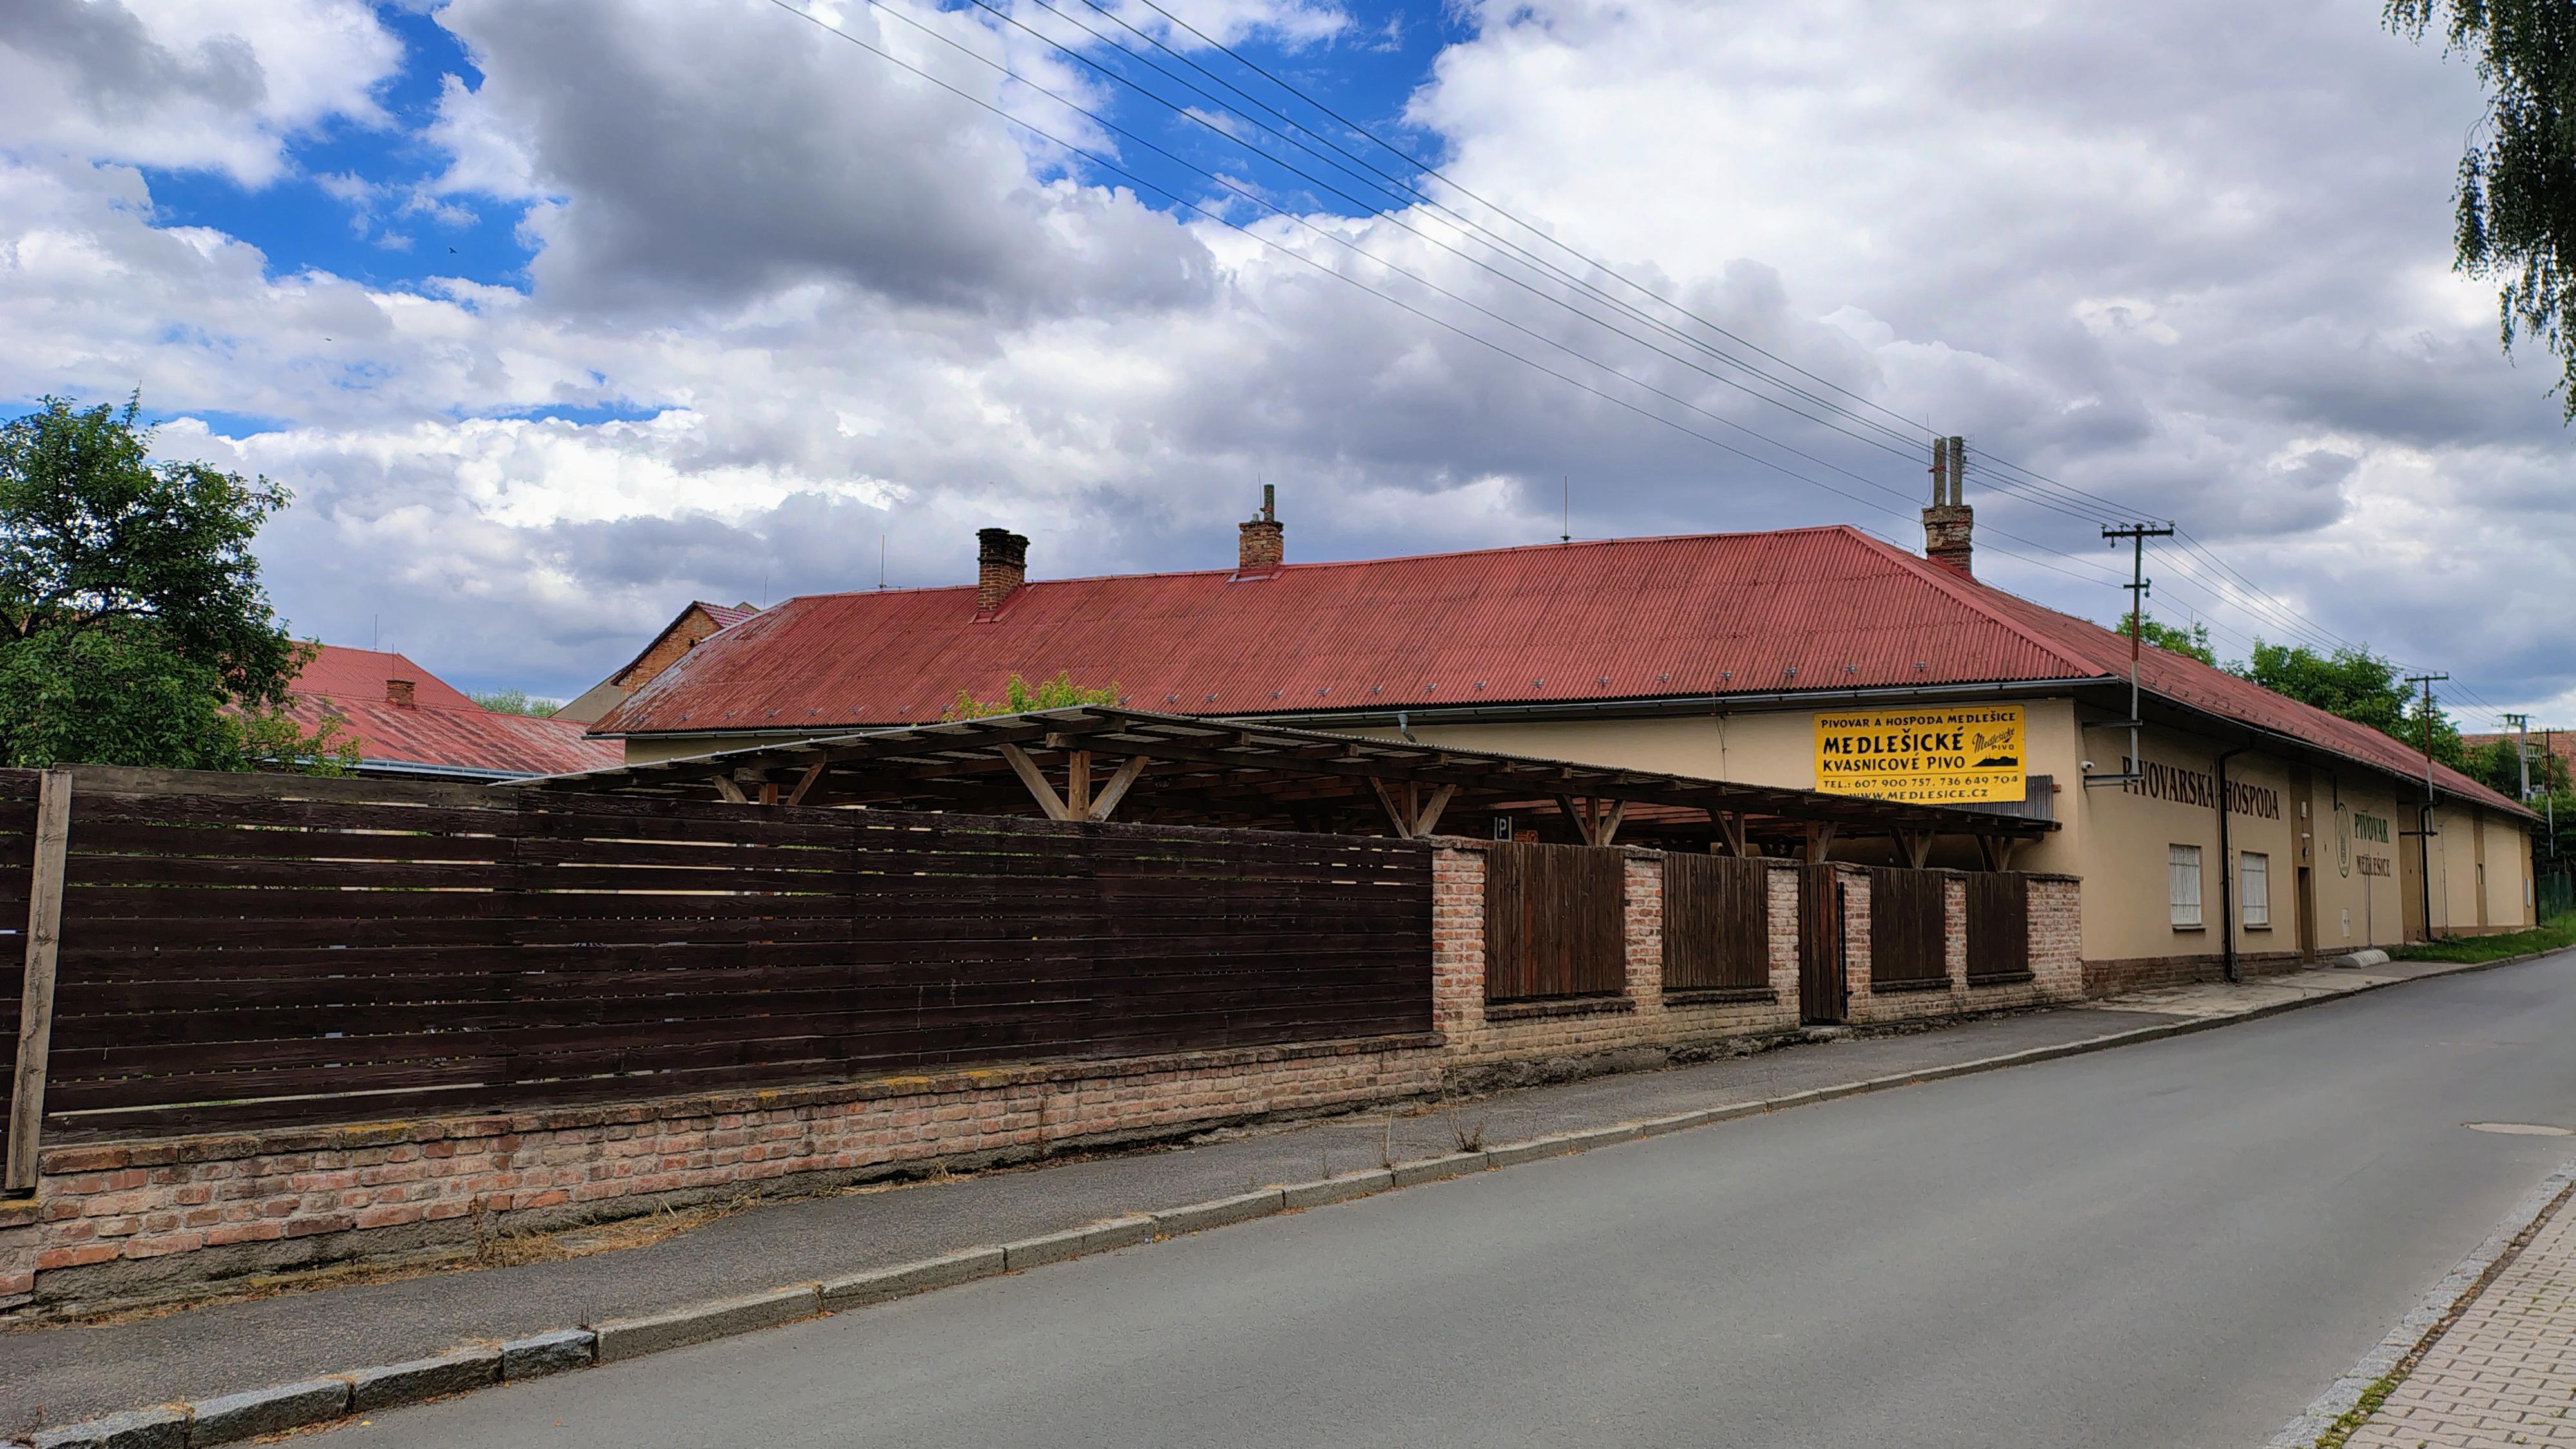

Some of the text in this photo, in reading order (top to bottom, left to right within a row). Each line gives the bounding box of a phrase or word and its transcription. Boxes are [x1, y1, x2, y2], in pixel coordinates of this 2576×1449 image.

[1821, 710, 2016, 728] PIVOVAR A HOSPODA MEDLEŠICE
[1823, 726, 1964, 755] MEDLEŠICKÉ
[1823, 752, 1965, 772] KVASNICOVÉ PIVO
[1823, 780, 1851, 788] TEL.:
[1855, 779, 1877, 788] 607
[1881, 779, 1908, 788] 900
[1940, 777, 1961, 786] 736
[1965, 776, 1989, 785] 649
[1993, 775, 2018, 784] 704
[1499, 819, 1507, 837] P
[2354, 813, 2389, 844] PIVOVAR
